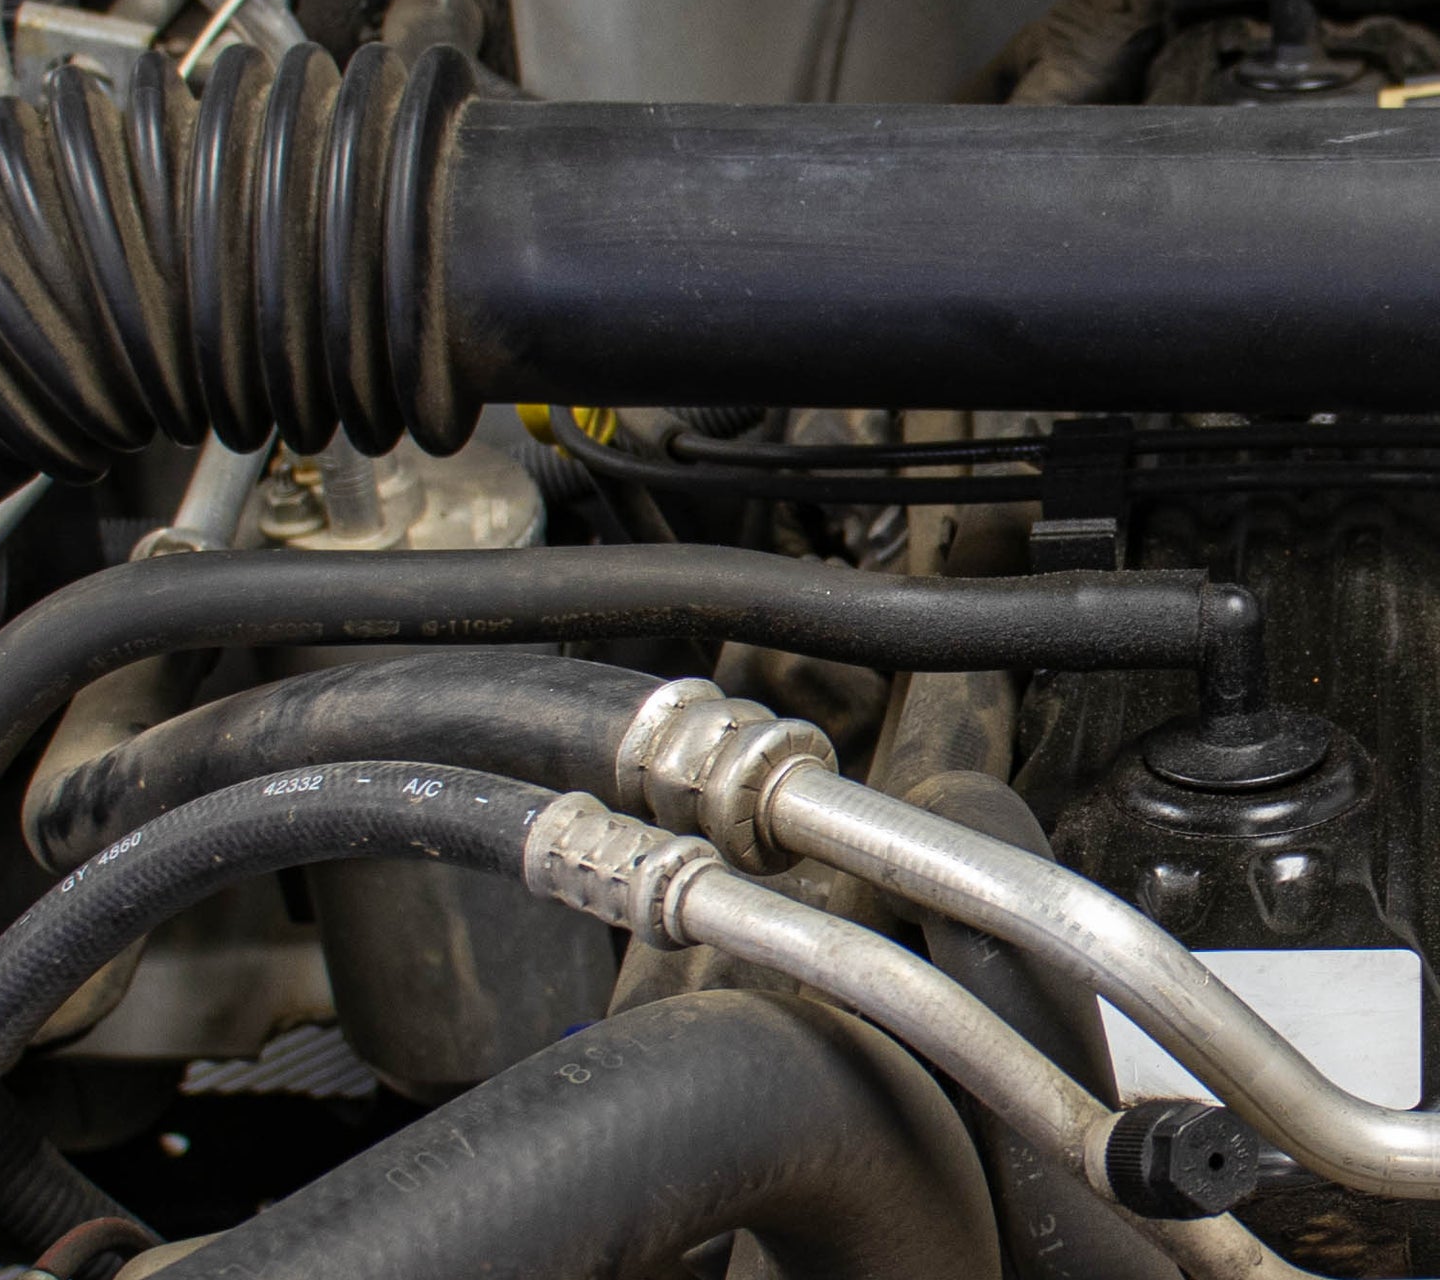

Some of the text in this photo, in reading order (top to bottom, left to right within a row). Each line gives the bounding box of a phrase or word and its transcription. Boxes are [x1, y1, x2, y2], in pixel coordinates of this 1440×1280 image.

[60, 862, 90, 894] GY
[97, 830, 143, 867] 4860
[263, 774, 325, 797] 42332
[402, 776, 444, 800] A/C
